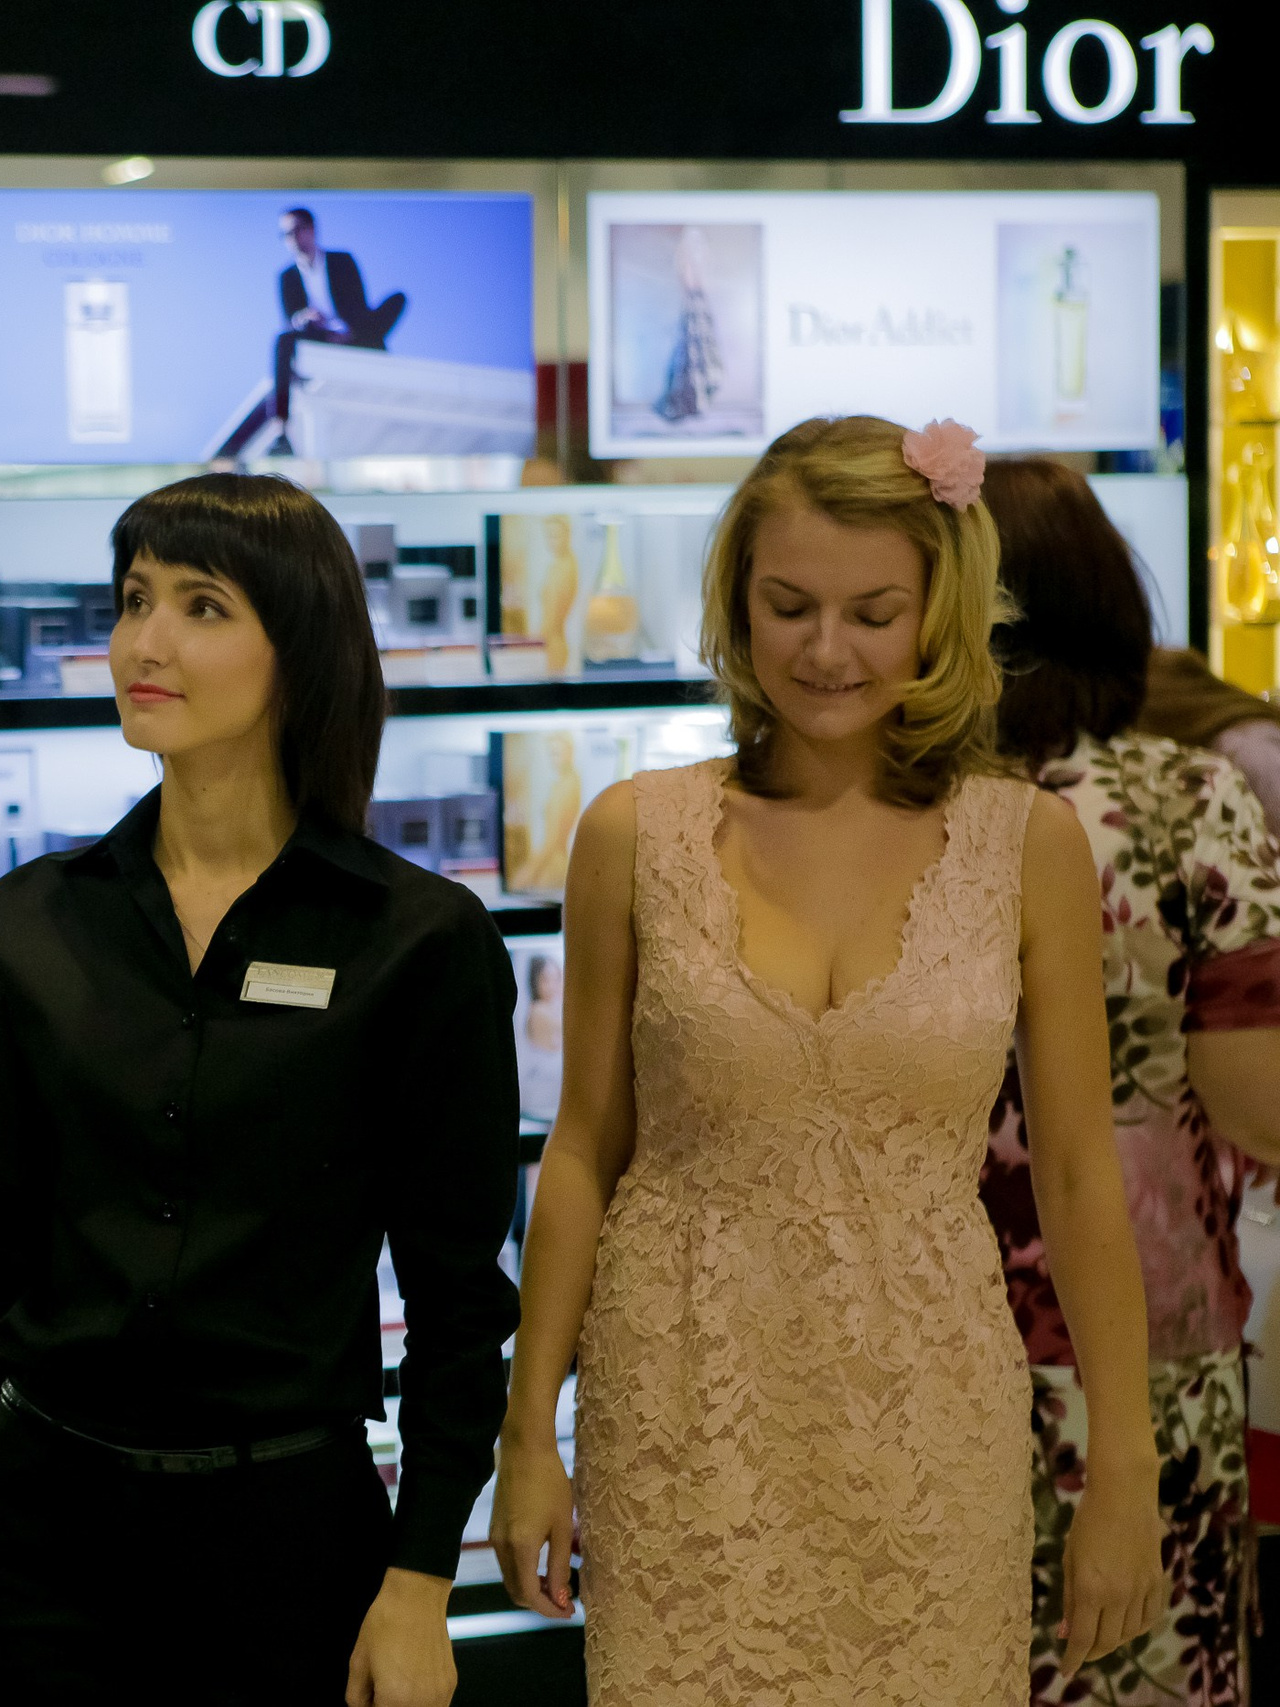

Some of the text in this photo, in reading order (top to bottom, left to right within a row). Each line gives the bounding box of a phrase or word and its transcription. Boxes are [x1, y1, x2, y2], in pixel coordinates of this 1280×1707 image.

[192, 0, 331, 77] CD
[839, 0, 1214, 124] Dior
[16, 222, 75, 243] DIOR
[787, 302, 974, 347] Dior Addict
